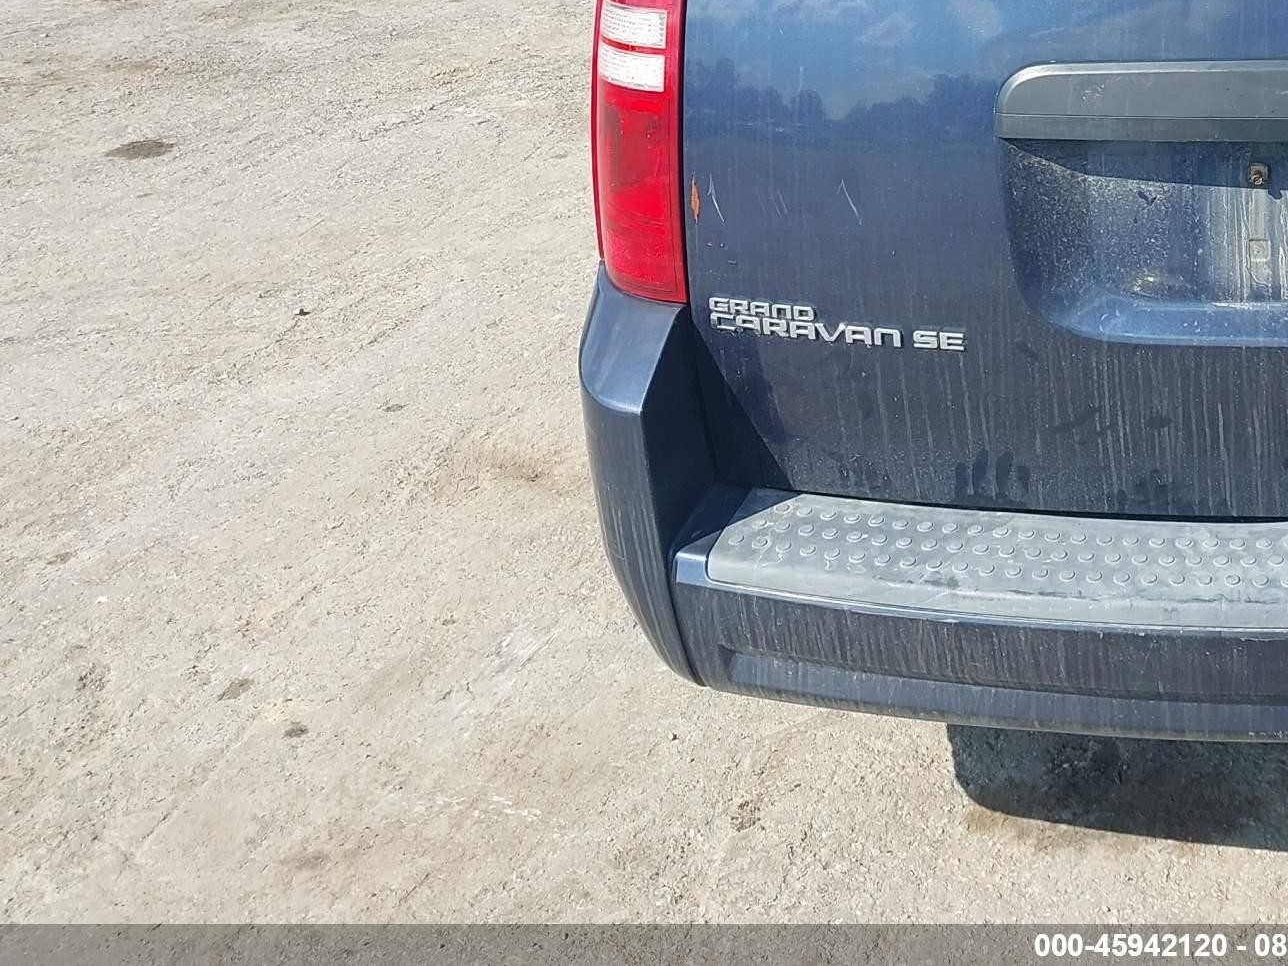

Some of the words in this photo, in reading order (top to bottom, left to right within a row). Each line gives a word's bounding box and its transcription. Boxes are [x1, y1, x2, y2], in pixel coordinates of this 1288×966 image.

[709, 297, 816, 322] GRAND
[710, 313, 902, 348] CARAVAN
[912, 329, 965, 352] SE
